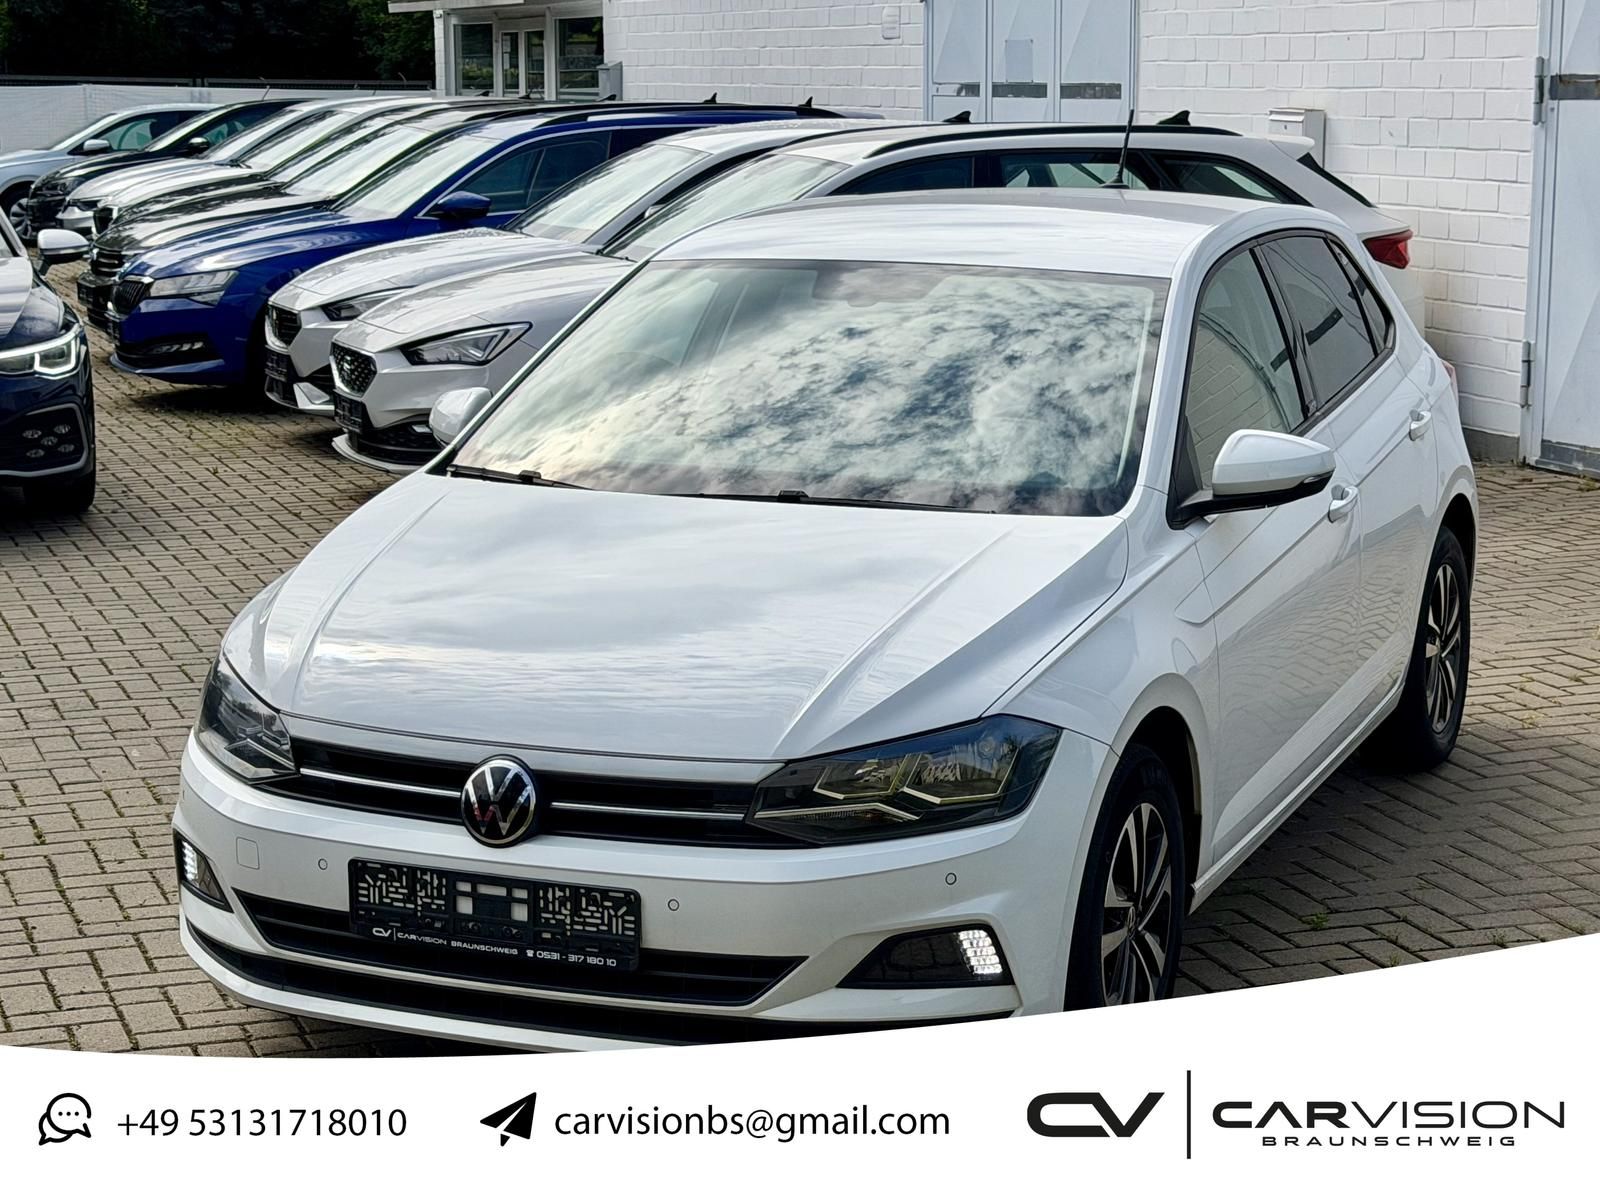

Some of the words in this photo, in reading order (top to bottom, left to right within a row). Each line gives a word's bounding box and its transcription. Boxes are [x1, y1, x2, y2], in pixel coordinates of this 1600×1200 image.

[397, 932, 447, 945] CARVISION
[450, 940, 519, 955] BRAUNSCHWEIG
[536, 950, 561, 961] 0531
[567, 953, 585, 963] 317
[586, 955, 604, 966] 180
[605, 958, 617, 967] 10
